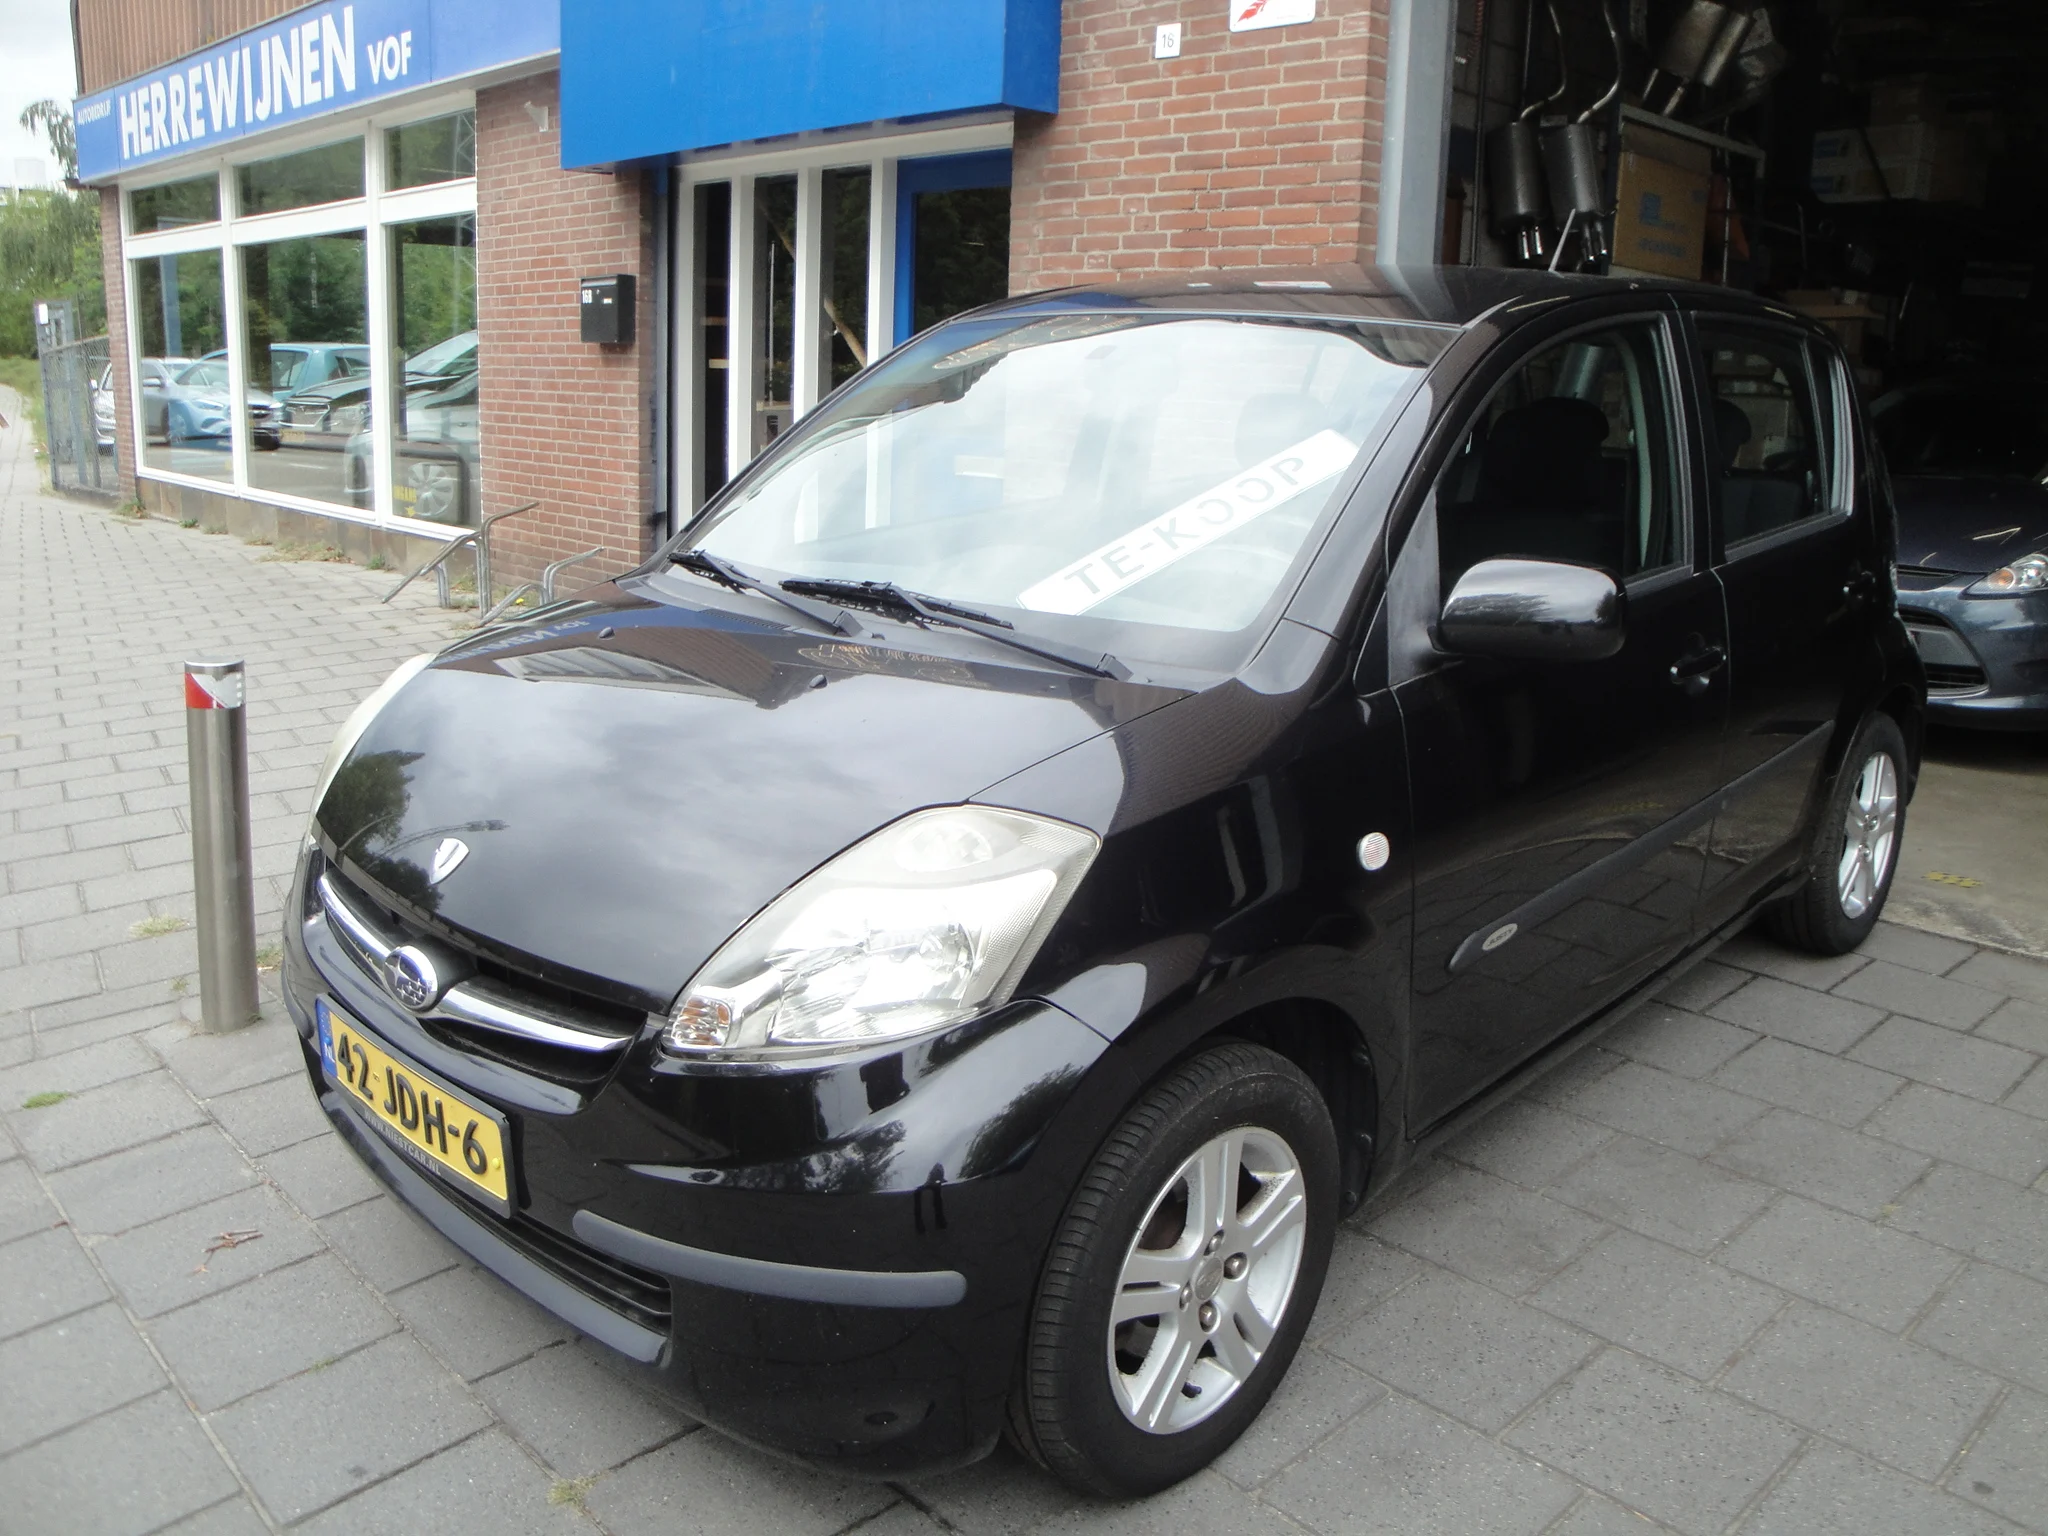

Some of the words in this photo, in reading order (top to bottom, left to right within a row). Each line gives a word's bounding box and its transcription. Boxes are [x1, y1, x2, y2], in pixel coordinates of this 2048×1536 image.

[1161, 33, 1175, 49] 16
[120, 6, 356, 160] HERREWIJNEN
[367, 30, 412, 84] VOF
[1064, 457, 1304, 594] TE-KOOP
[323, 1042, 336, 1063] NL
